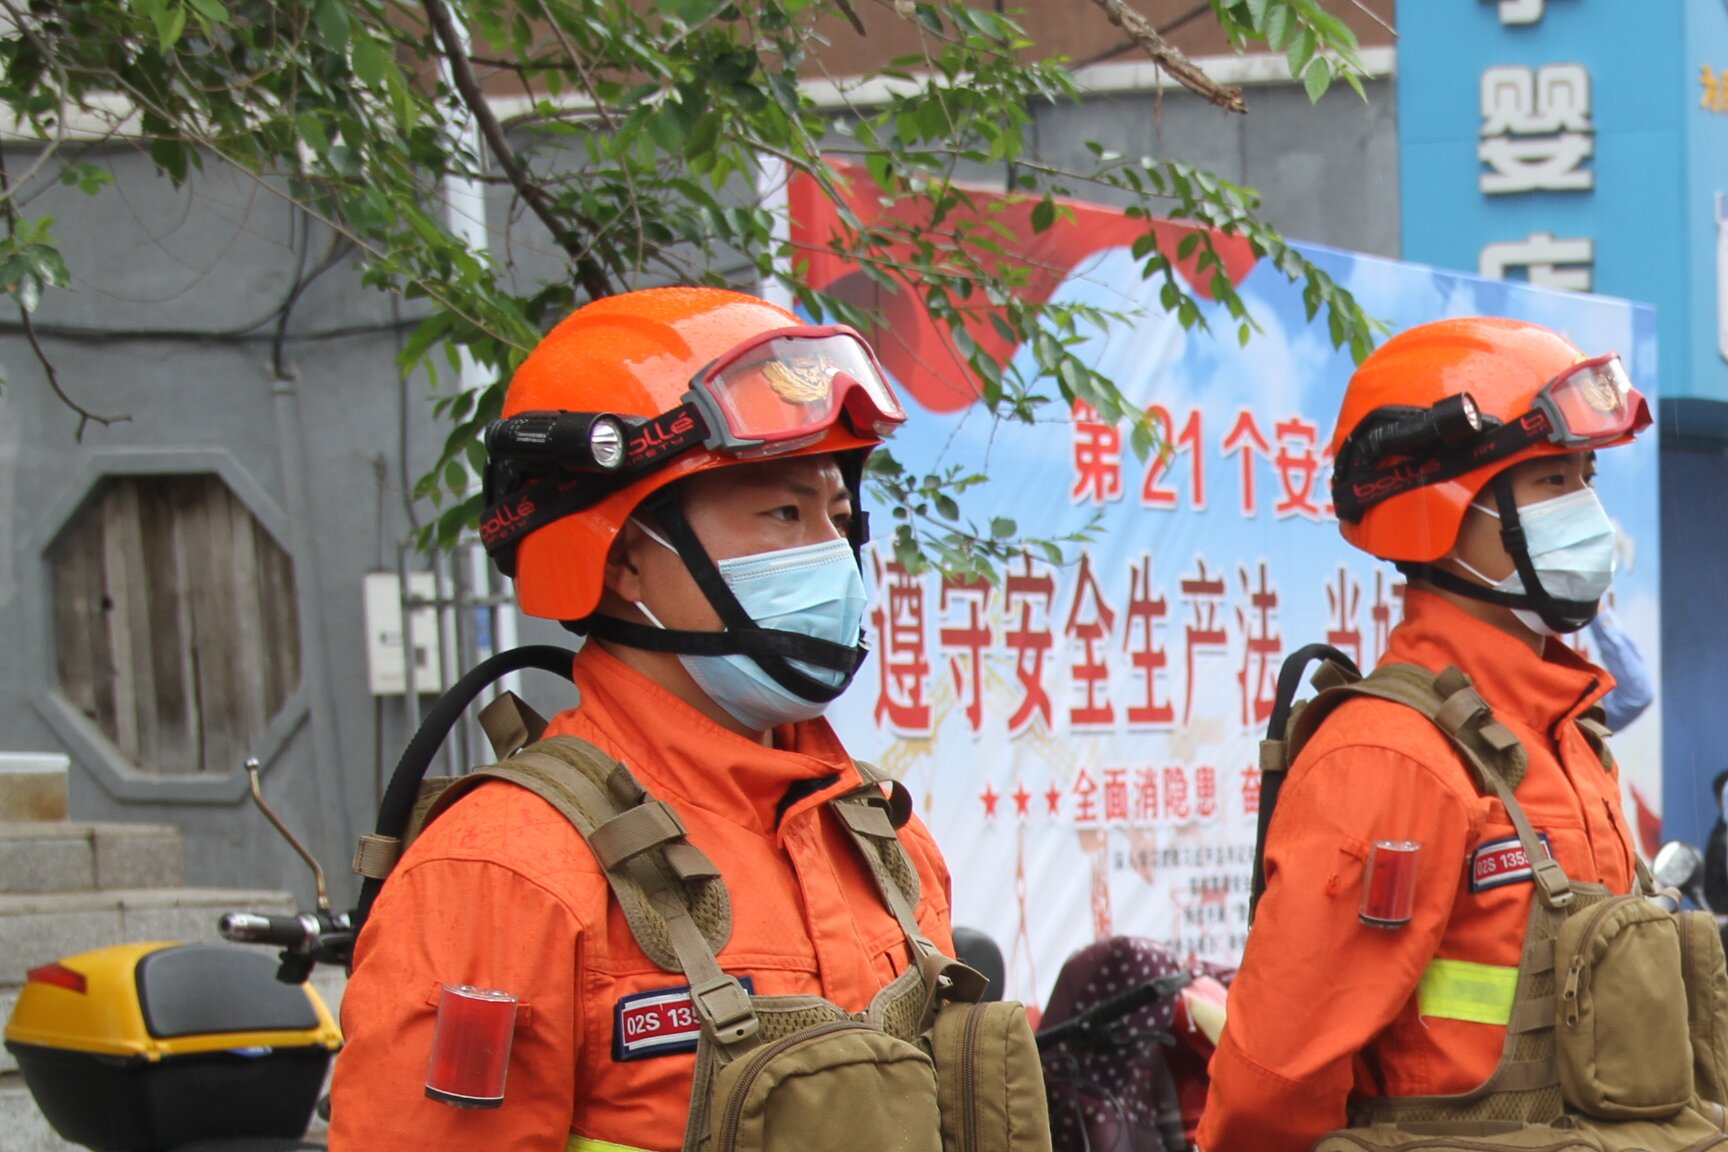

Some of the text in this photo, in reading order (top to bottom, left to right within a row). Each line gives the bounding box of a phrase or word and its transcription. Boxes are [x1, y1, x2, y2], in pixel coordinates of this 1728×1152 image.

[629, 410, 696, 456] ollé
[870, 545, 1283, 737] 遵守安全生产法
[1073, 766, 1217, 824] 全面消隐患
[1477, 850, 1530, 875] 02S 135
[627, 1012, 661, 1036] 02S
